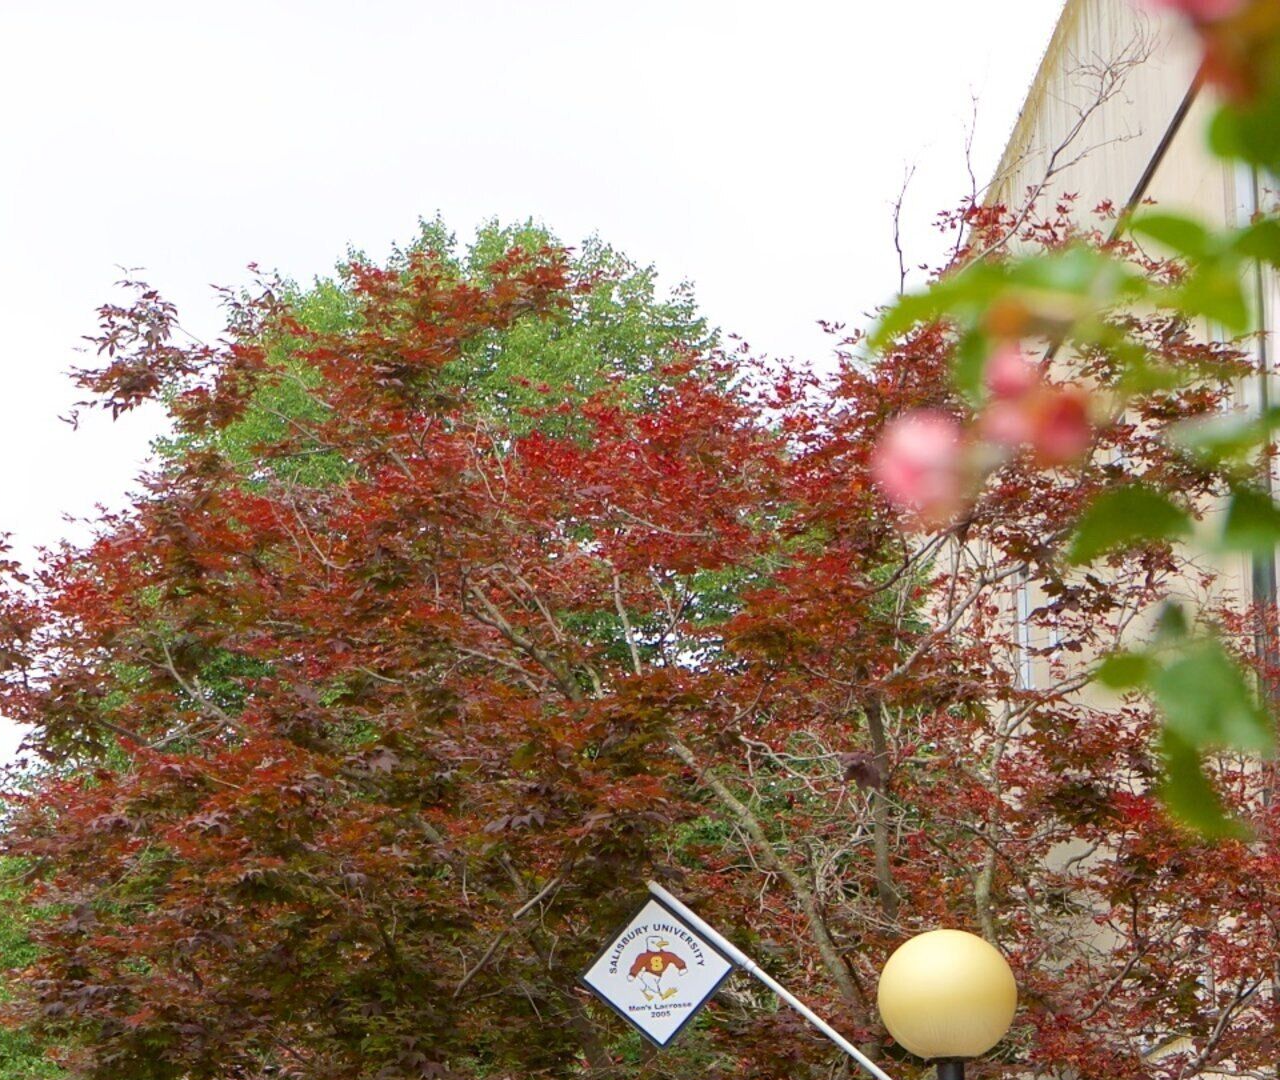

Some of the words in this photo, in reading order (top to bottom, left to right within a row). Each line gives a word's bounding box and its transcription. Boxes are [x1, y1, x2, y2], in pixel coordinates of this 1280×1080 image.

[609, 924, 650, 975] SALISBURY
[652, 923, 706, 967] UNIVERSITY
[628, 1004, 652, 1012] Men's
[654, 1002, 692, 1010] Lacrosse
